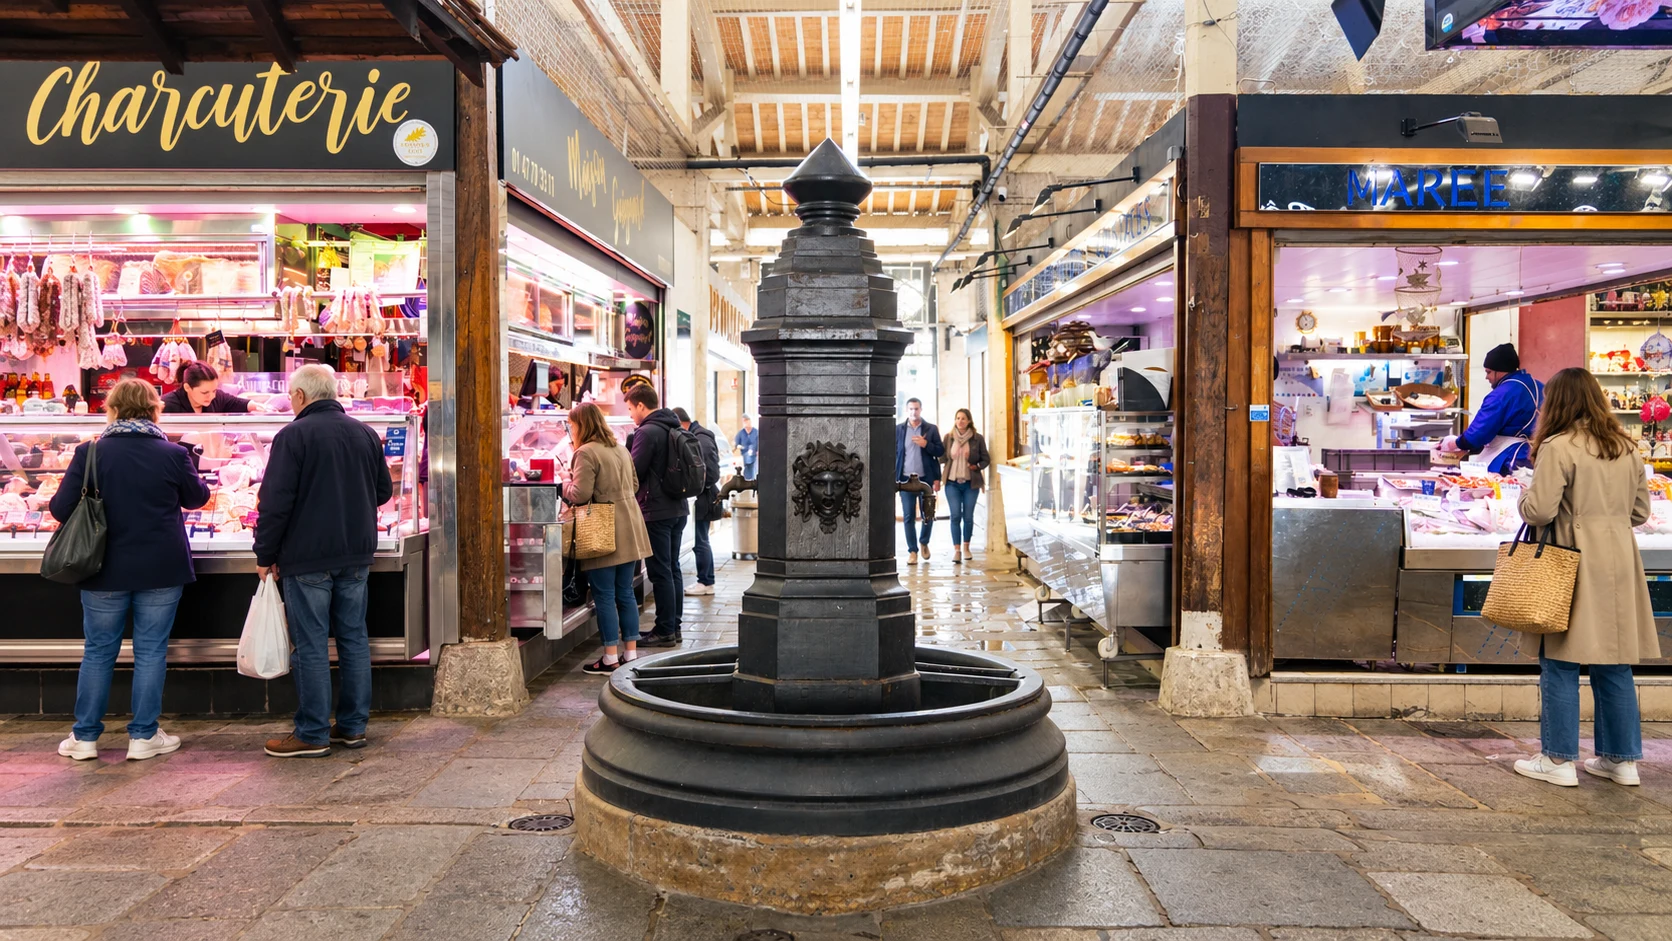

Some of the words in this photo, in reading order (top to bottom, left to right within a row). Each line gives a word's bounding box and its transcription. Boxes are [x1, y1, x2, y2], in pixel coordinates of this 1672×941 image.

[26, 60, 411, 154] Charcuterie
[511, 147, 520, 175] 01
[1346, 168, 1511, 208] MAREE
